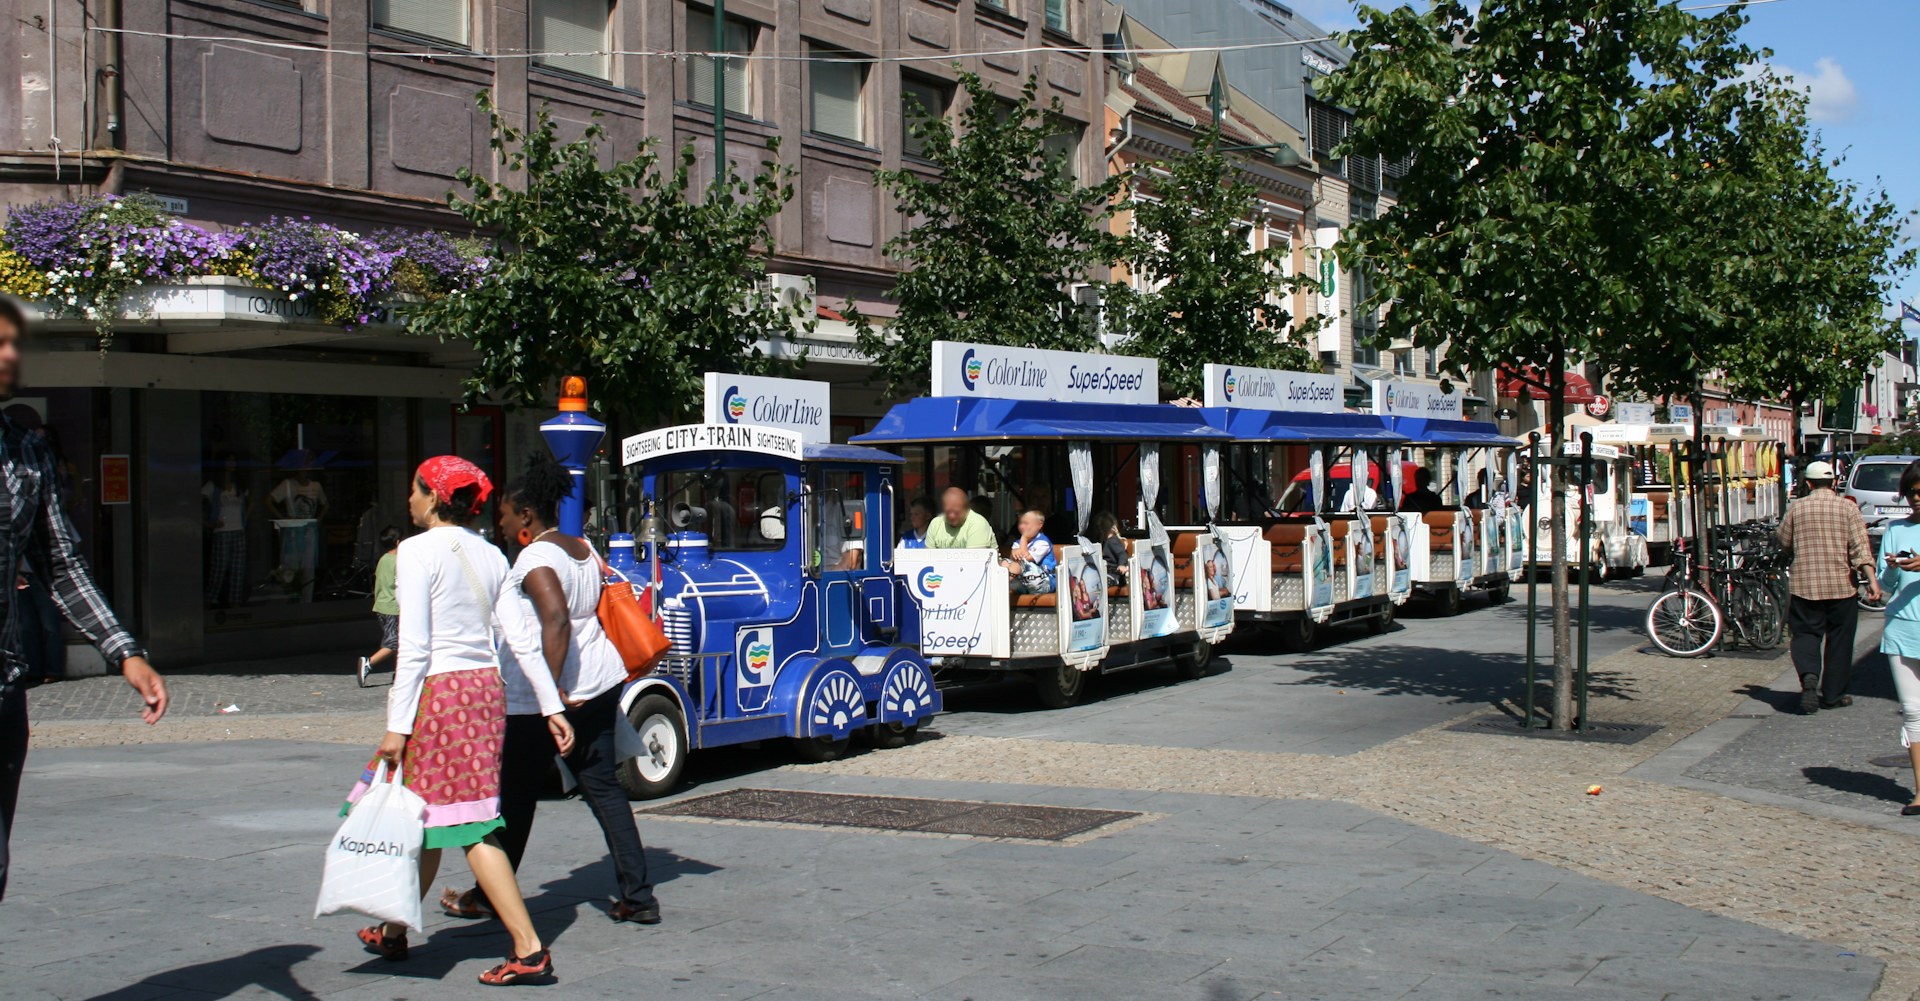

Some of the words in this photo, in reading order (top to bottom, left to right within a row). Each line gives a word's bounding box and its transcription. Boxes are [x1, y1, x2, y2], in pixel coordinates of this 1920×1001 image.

[1067, 365, 1143, 394] SuperSpeed
[1288, 381, 1335, 403] SuperSpeed
[626, 436, 661, 459] SIGHTSEEING
[757, 432, 796, 454] SIGHTSEEING
[338, 836, 403, 857] KappAhl
